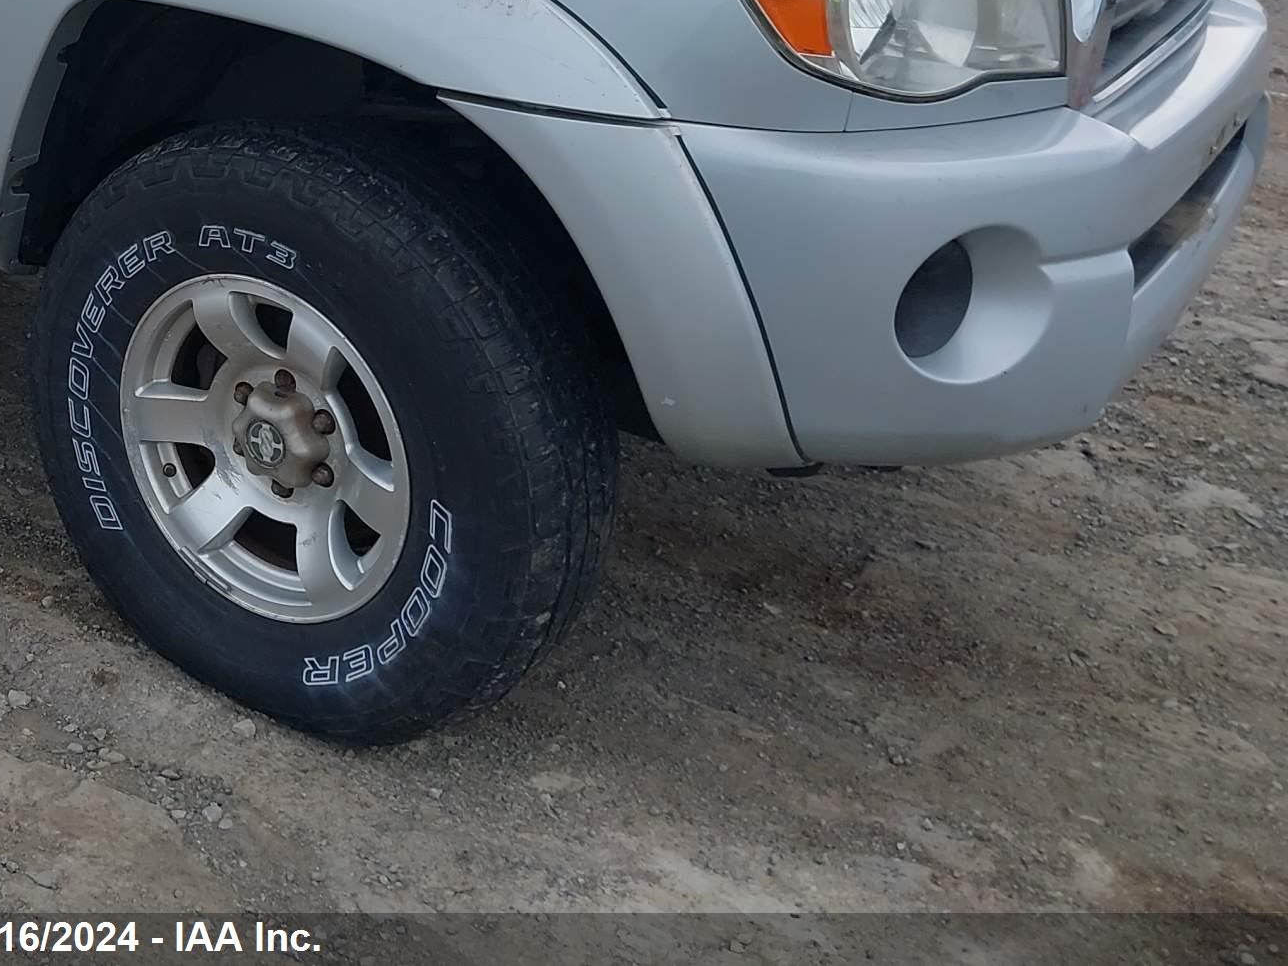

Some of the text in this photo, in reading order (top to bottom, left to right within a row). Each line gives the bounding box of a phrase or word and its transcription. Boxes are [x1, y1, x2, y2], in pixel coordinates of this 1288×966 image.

[68, 225, 297, 531] DISCOVERER AT3
[302, 499, 453, 686] COOPER
